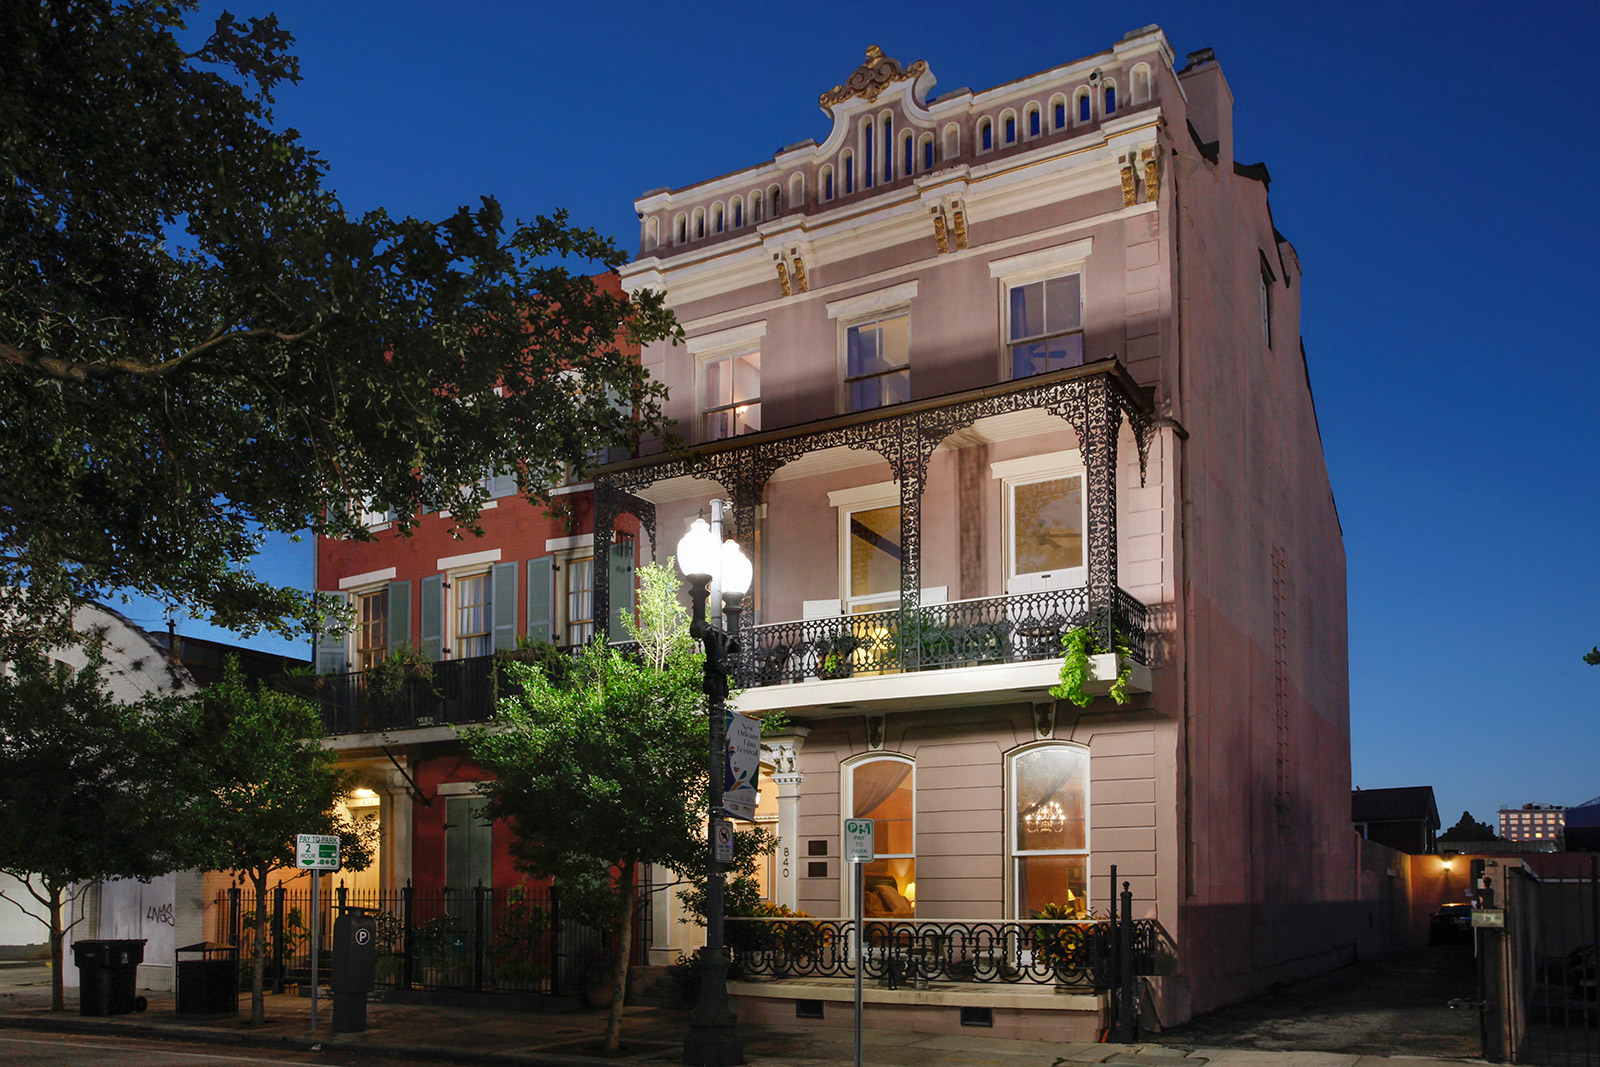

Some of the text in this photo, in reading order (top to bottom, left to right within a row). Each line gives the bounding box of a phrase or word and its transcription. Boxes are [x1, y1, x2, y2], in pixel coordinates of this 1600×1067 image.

[741, 722, 753, 731] New
[737, 729, 759, 740] Orleans
[743, 739, 756, 749] Film
[736, 745, 759, 757] Festival
[299, 835, 311, 843] PAY
[321, 836, 338, 844] PARK
[305, 843, 311, 853] 2
[782, 847, 790, 878] 840
